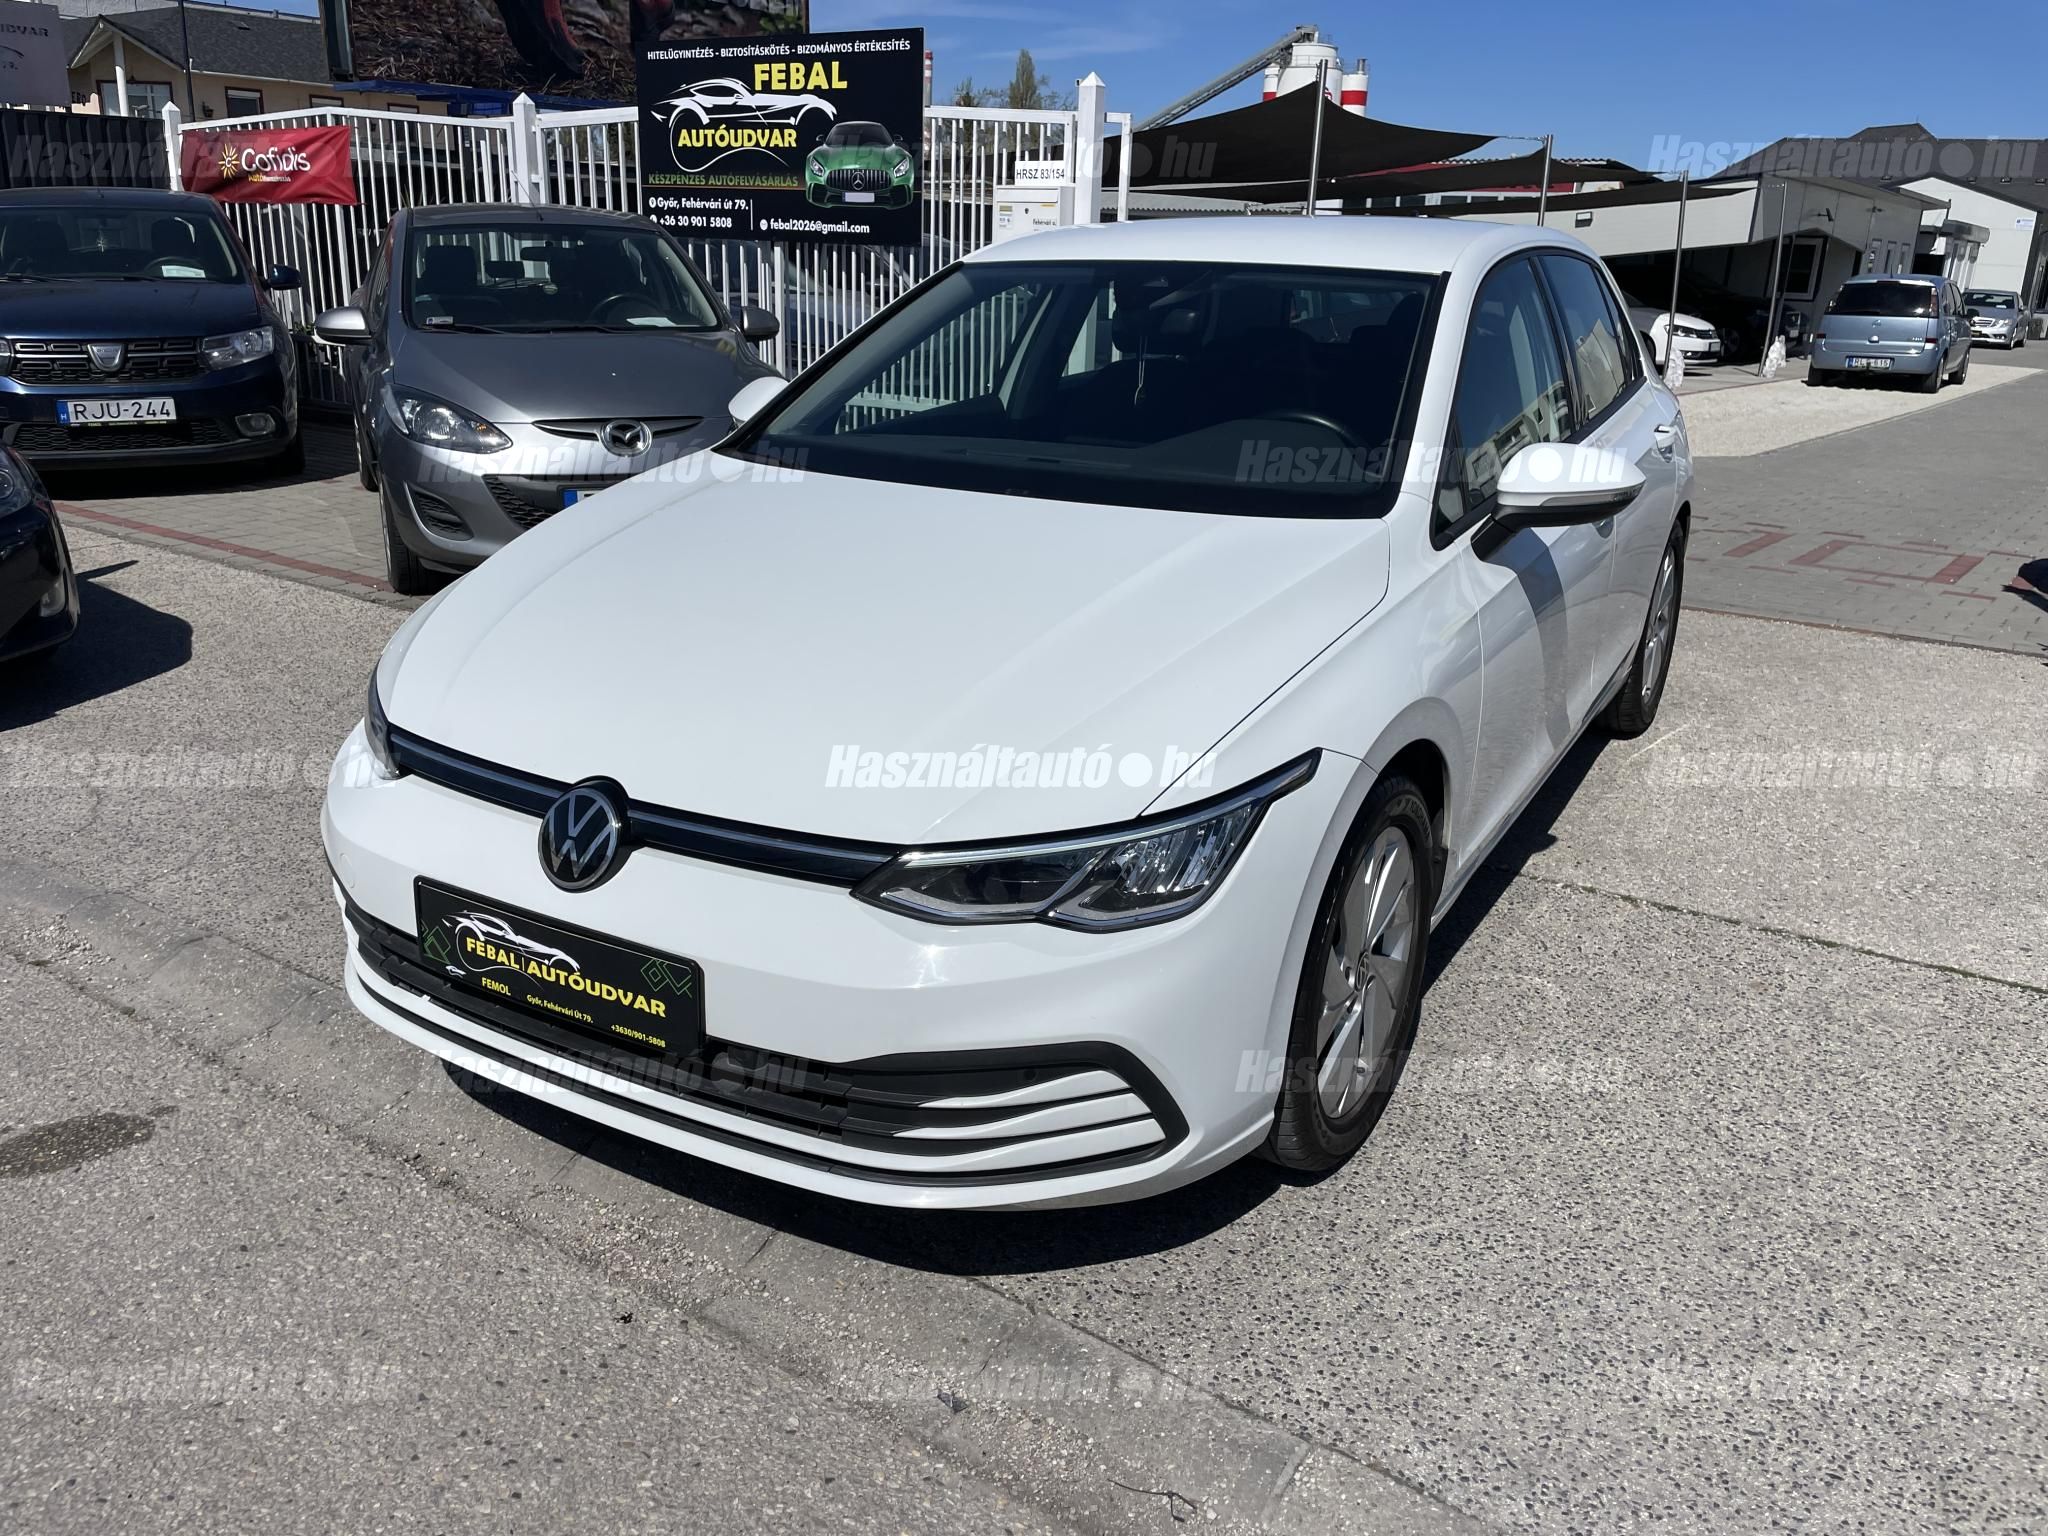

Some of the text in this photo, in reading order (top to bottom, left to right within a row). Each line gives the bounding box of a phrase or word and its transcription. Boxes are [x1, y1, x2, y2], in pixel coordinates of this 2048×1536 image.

[647, 47, 714, 60] HITELÜGYINTÉZÉS
[720, 44, 790, 57] BIZTOSÍTÁSKÖTÉS
[797, 42, 853, 55] BIZOMÁNYOS
[854, 38, 911, 52] ÉRTÉKESÍTÉS
[754, 61, 848, 91] FEBAL
[677, 124, 797, 148] AUTÓUDVAR
[241, 146, 311, 172] Cofidis
[1016, 168, 1065, 180] HRSZ 83/154
[657, 197, 749, 211] Győr, Fehérvári út 79.
[659, 215, 732, 229] +36 30 901 5808
[770, 218, 870, 235] febal2026@gmail.com
[73, 401, 171, 421] RJU-244
[466, 937, 666, 1018] FEBAL AUTÓUDVAR
[482, 977, 511, 996] FEMOL
[611, 1024, 666, 1048] +3630/901-5808
